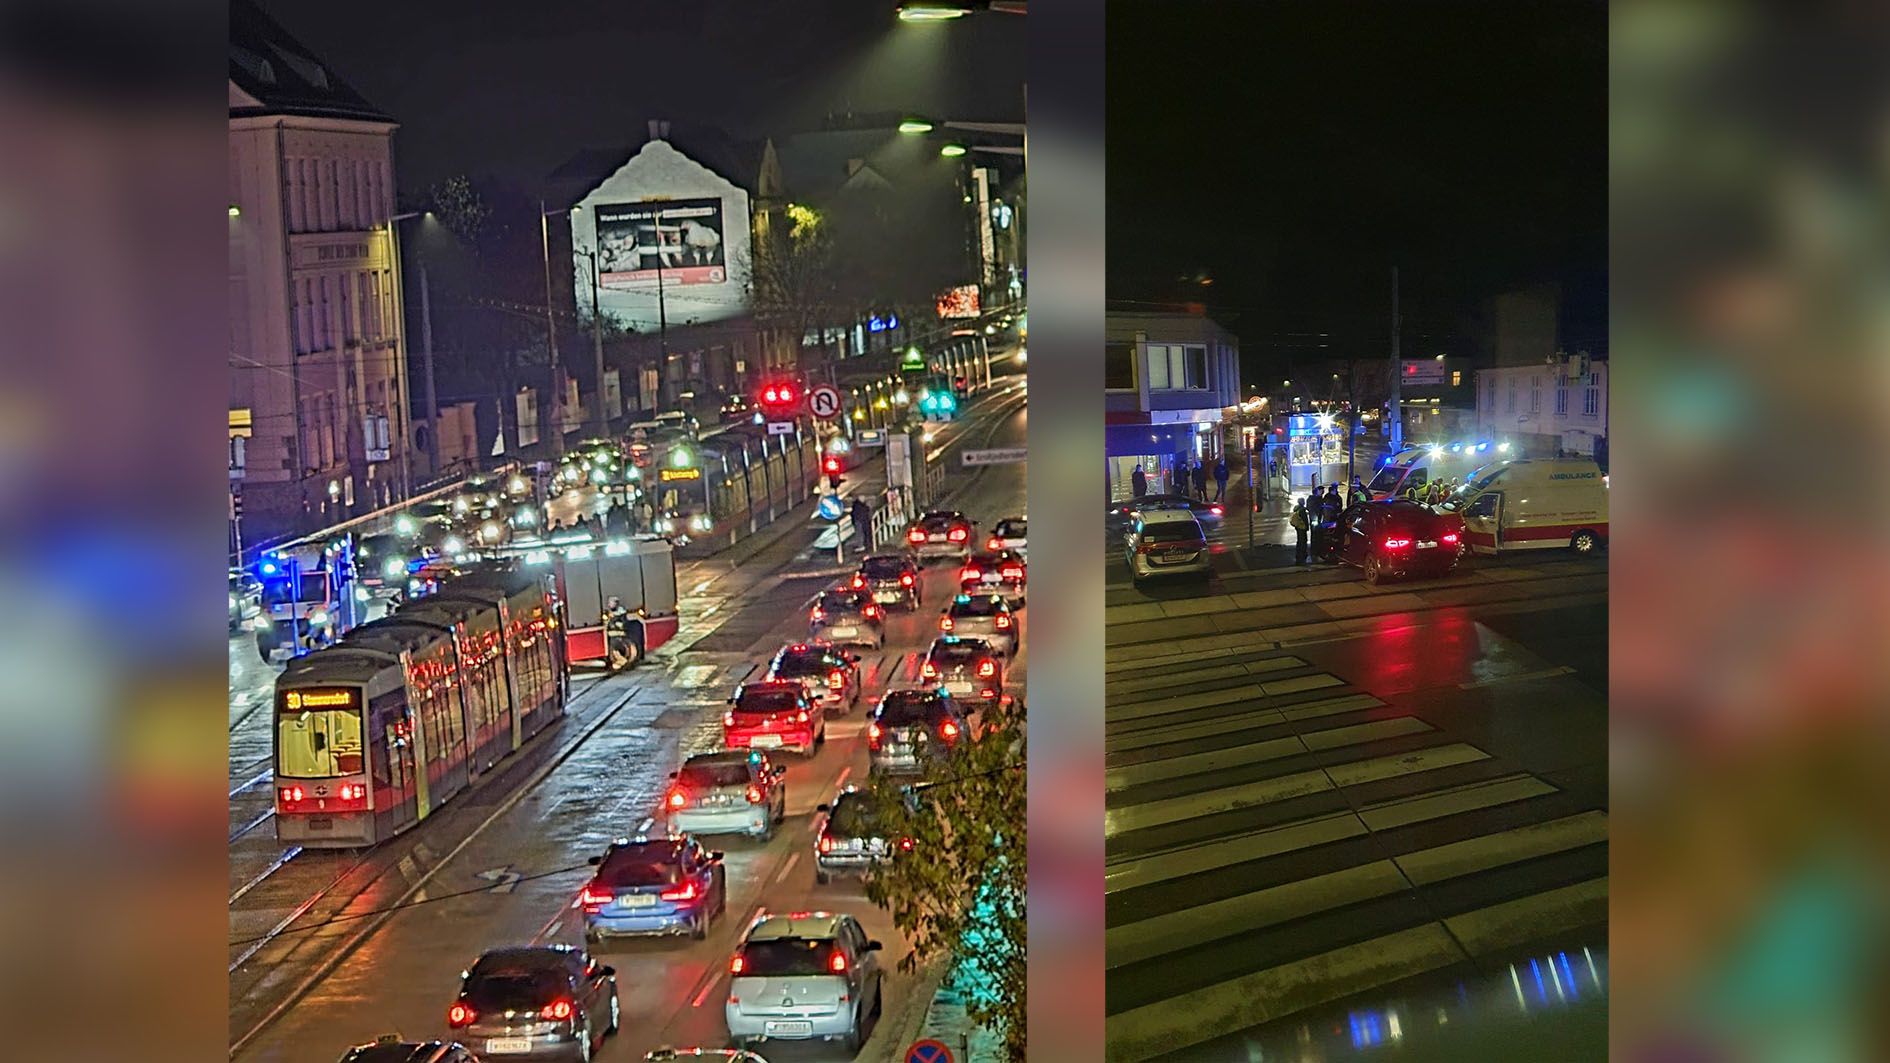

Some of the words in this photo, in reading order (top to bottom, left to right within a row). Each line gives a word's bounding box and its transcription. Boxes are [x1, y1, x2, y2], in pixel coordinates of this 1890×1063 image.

[600, 213, 618, 222] Wann
[618, 211, 642, 221] wurden
[1549, 471, 1596, 480] AMBULANCE
[287, 692, 301, 709] 30
